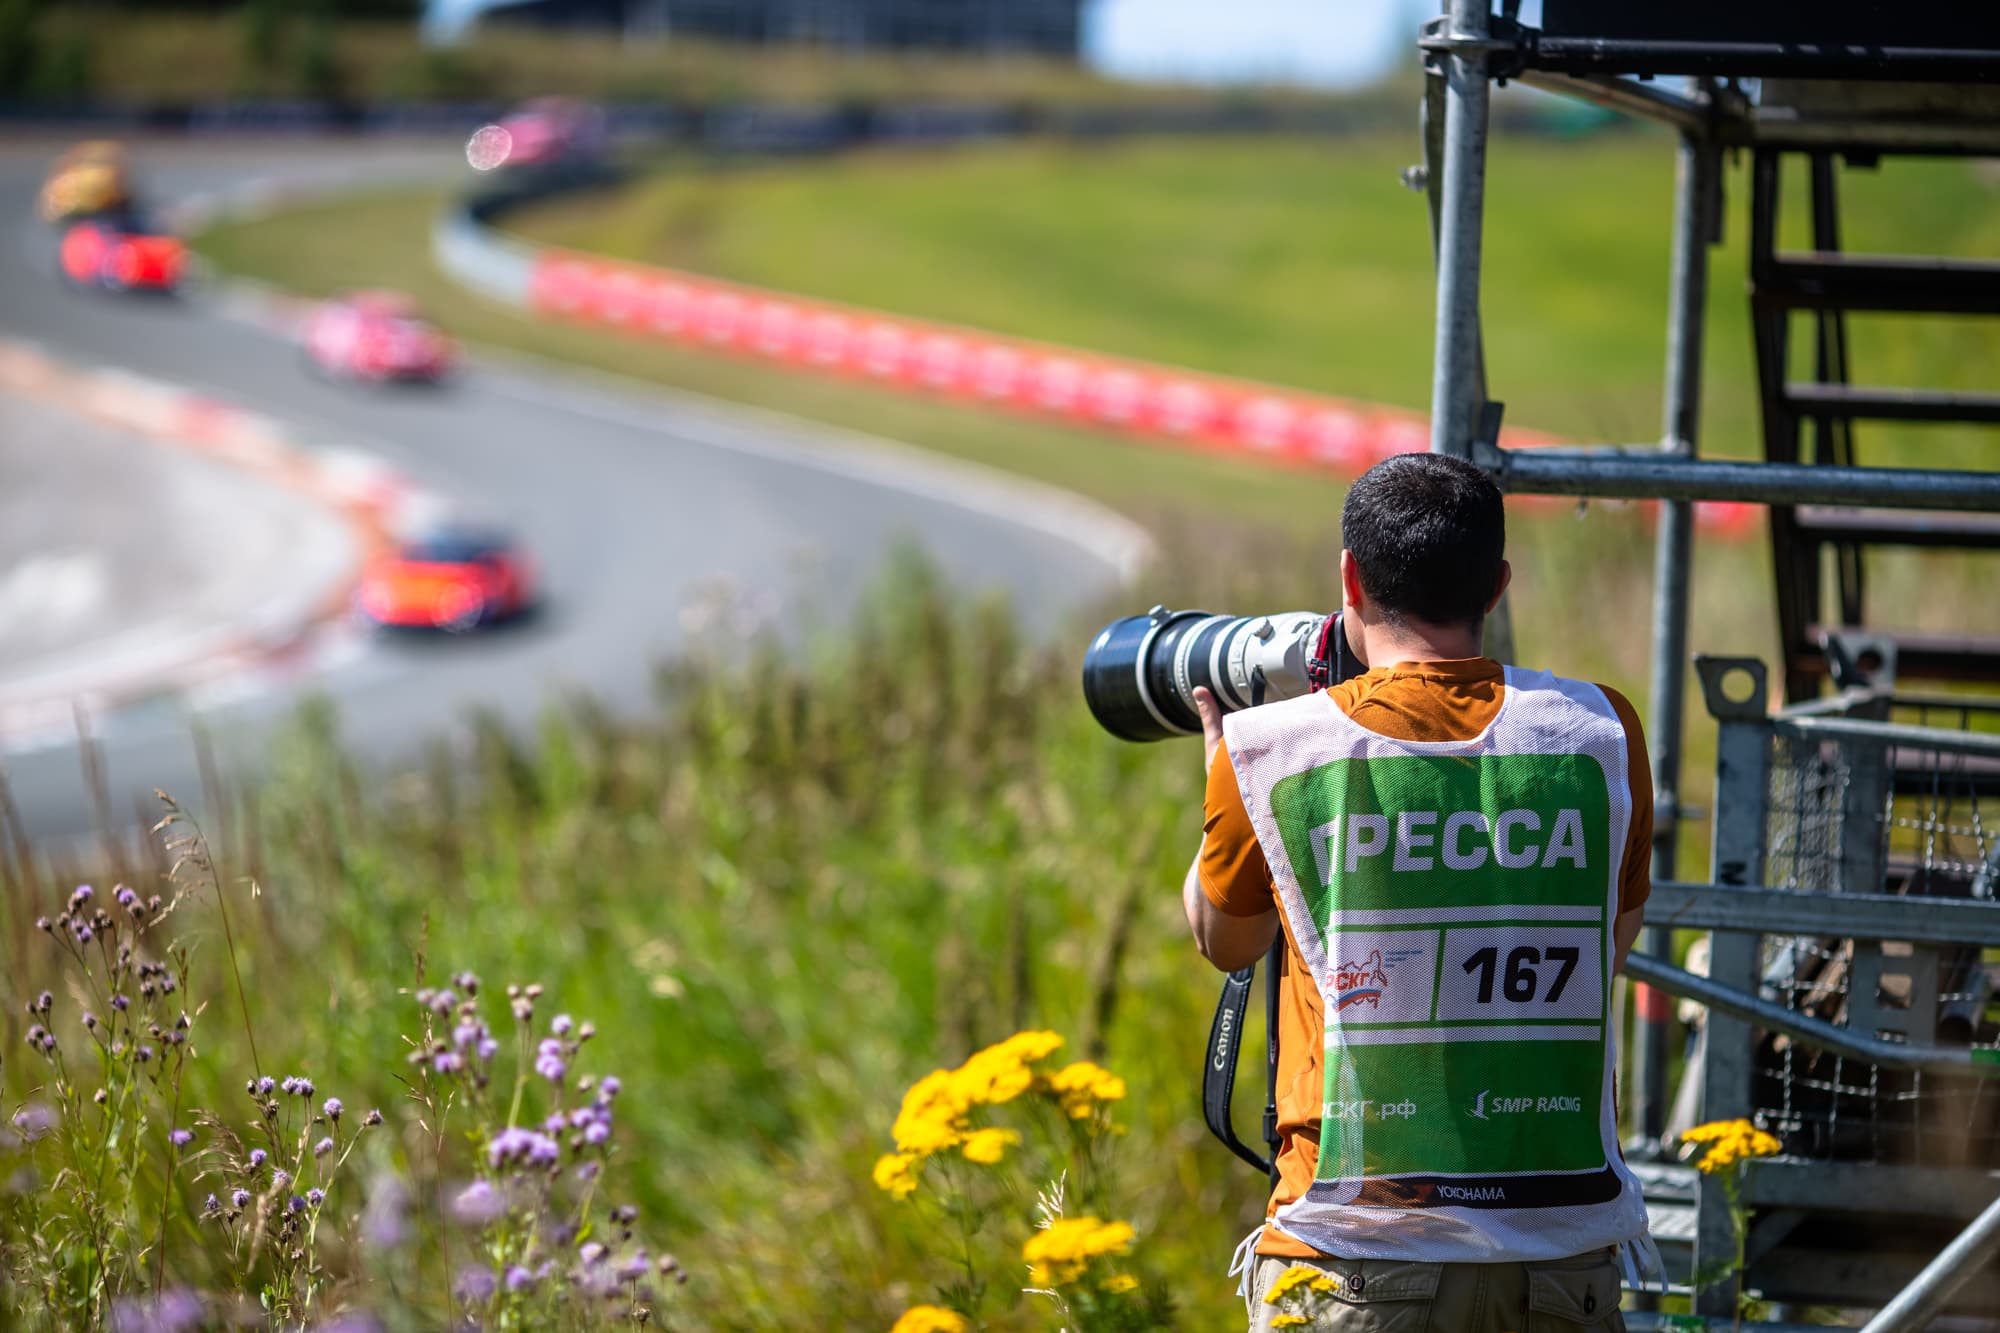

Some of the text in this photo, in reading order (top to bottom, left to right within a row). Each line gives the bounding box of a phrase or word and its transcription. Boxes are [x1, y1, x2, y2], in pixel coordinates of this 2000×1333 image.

[1462, 946, 1580, 1004] 167
[1214, 1008, 1234, 1071] Canon
[1492, 1097, 1533, 1113] SMP
